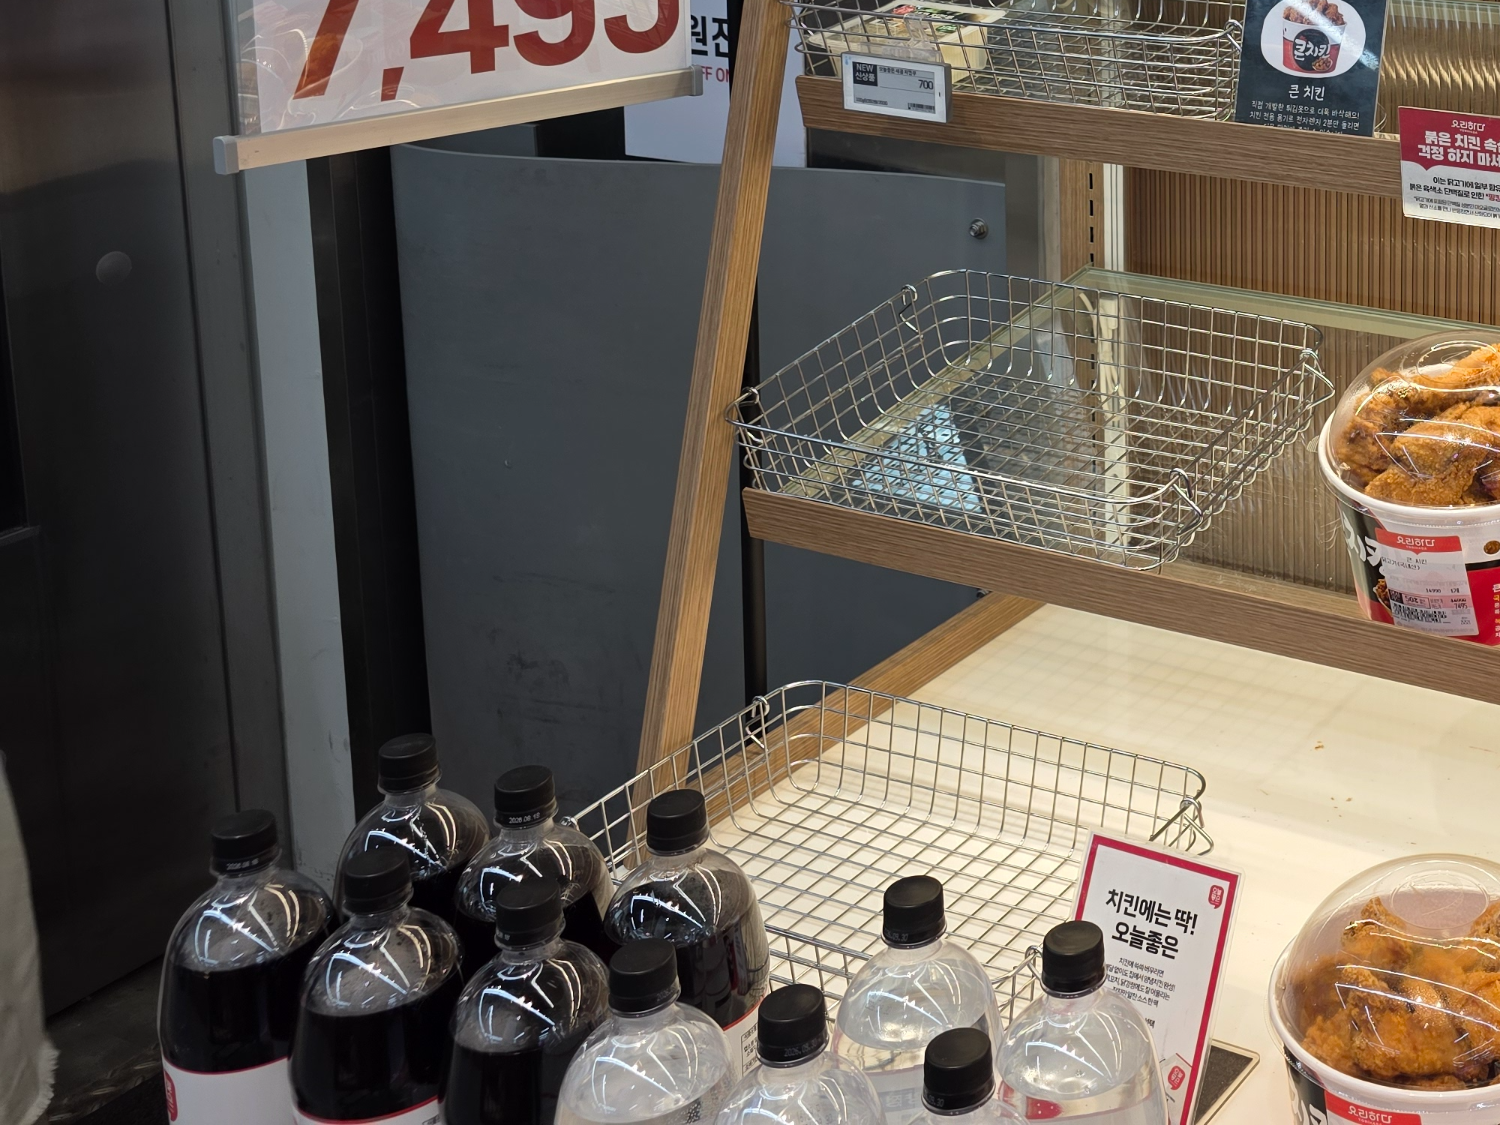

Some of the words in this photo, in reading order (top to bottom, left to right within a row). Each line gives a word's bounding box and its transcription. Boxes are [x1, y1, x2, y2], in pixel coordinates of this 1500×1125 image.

[1293, 38, 1331, 62] 큰치킨
[918, 79, 934, 90] 700
[1288, 84, 1300, 100] 큰
[1304, 86, 1325, 102] 치킨
[1451, 119, 1486, 132] 요리하다
[1425, 130, 1451, 146] 붉은
[1454, 134, 1481, 151] 치킨
[1418, 144, 1445, 161] 걱정
[1448, 148, 1474, 165] 하지
[1397, 536, 1435, 547] 요리하다
[1105, 889, 1171, 927] 치킨에는
[1175, 907, 1198, 935] 딱!
[1112, 922, 1179, 960] 오늘좋은
